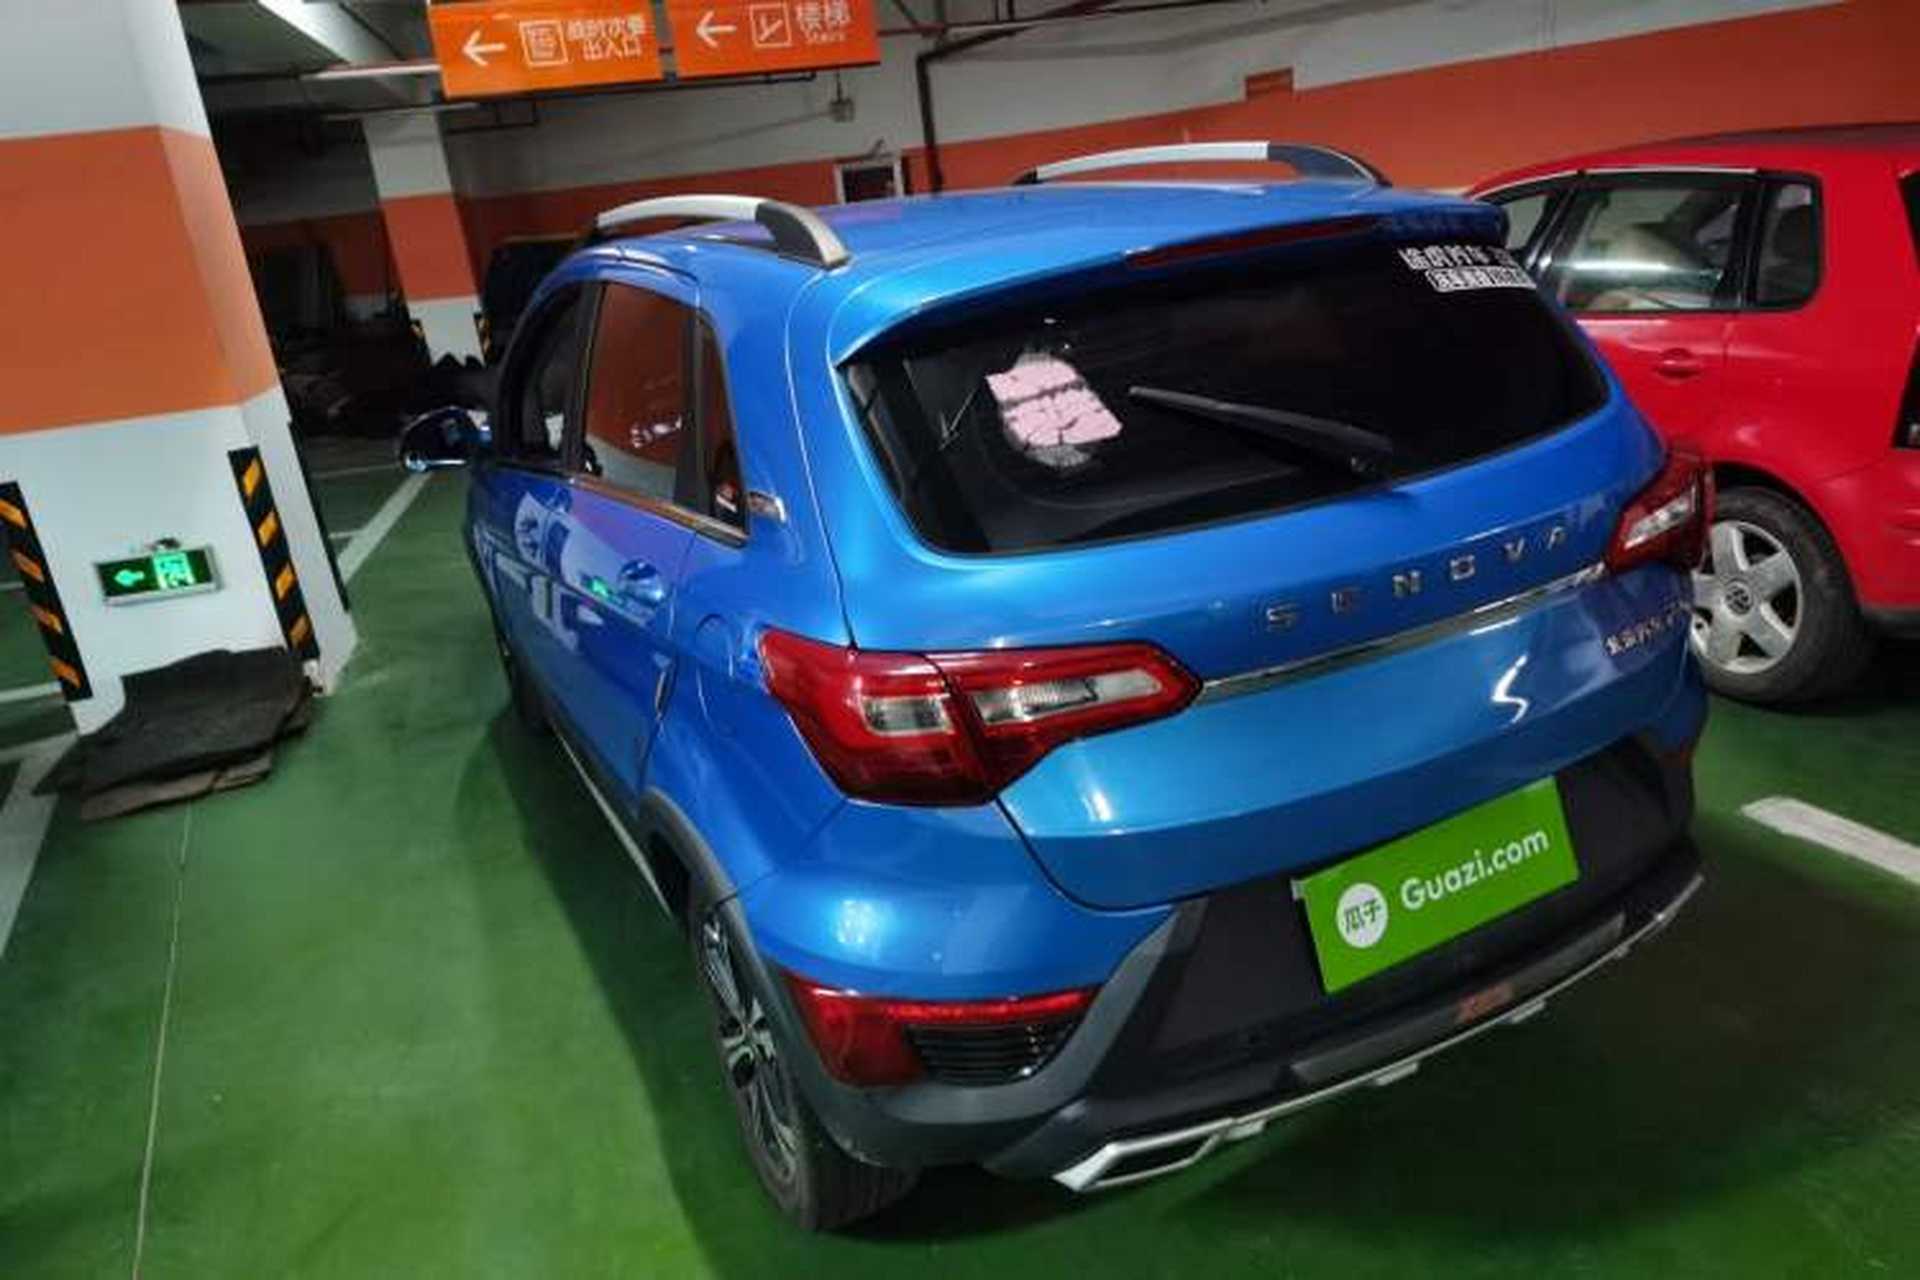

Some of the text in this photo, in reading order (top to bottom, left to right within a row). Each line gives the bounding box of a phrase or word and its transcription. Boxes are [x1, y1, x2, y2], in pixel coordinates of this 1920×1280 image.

[583, 34, 642, 61] 出入口
[1265, 525, 1566, 630] SENOVA
[1400, 829, 1550, 911] Guazi.com
[1343, 896, 1383, 935] 瓜子
